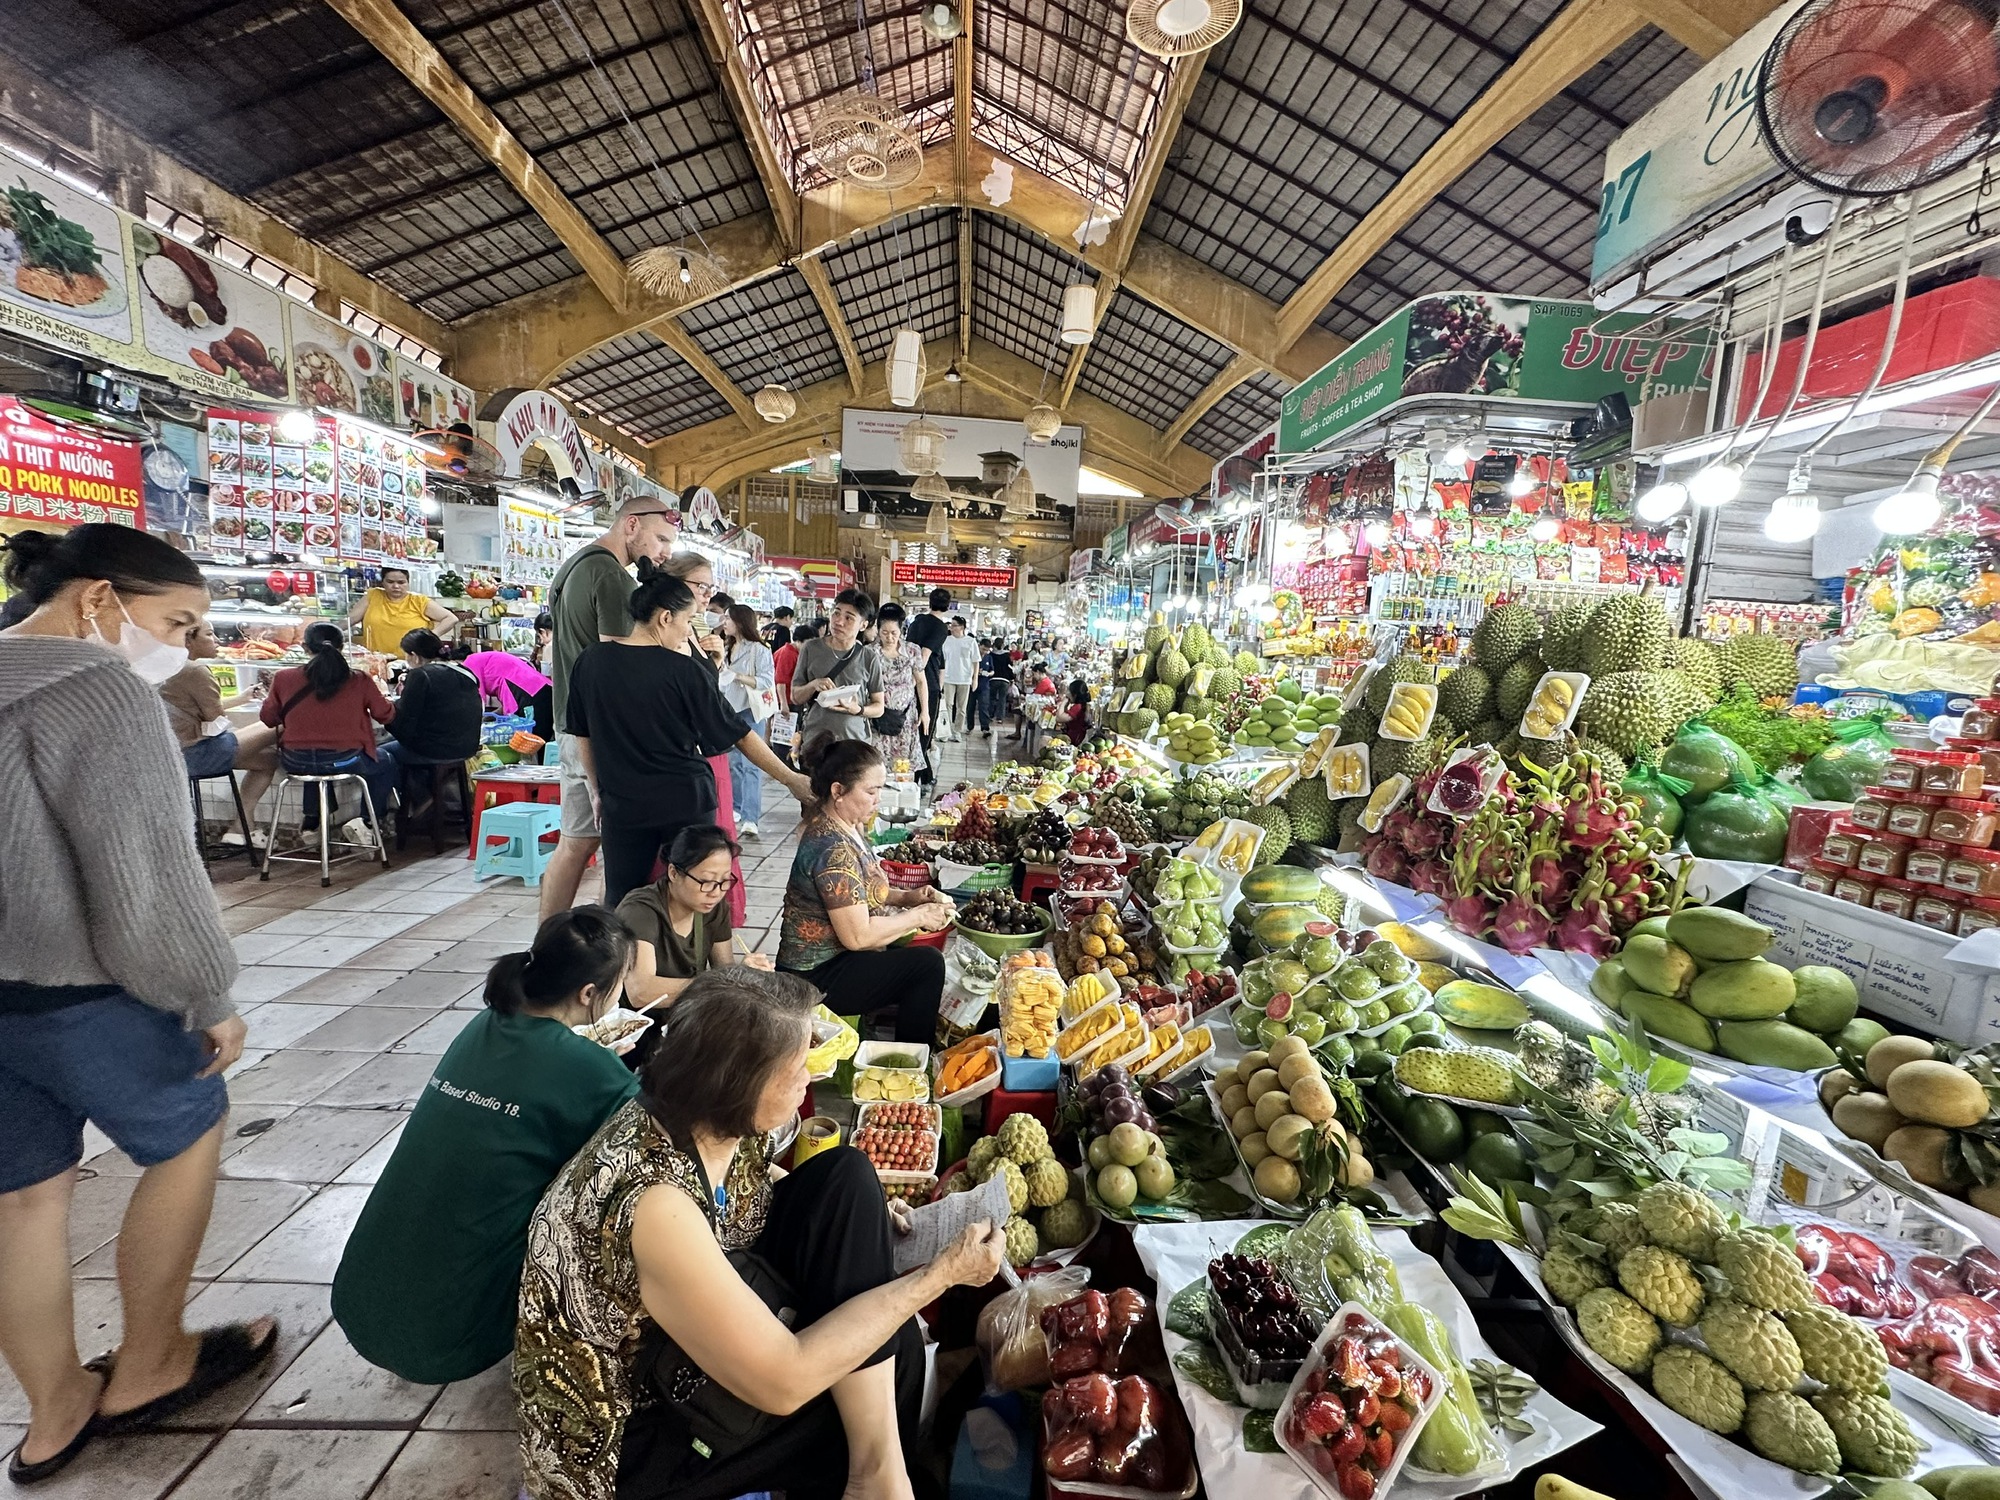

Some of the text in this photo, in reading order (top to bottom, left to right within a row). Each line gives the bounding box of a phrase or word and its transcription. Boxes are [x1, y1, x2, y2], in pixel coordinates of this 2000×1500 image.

[1560, 305, 1583, 318] 1069
[36, 325, 91, 351] PANCAKE
[176, 371, 231, 397] VIETNAMESE
[1351, 338, 1395, 392] TRANG
[236, 388, 254, 398] NAM
[1300, 422, 1319, 440] FRUITS
[1322, 406, 1344, 428] COFFEE
[1344, 405, 1350, 414] &
[1351, 396, 1363, 410] TEA
[1364, 382, 1384, 403] SHOP
[507, 402, 536, 449] KHU
[539, 395, 558, 435] ĂN
[12, 441, 54, 471] THỊT
[58, 450, 115, 481] NƯỚNG
[1050, 438, 1079, 450] shojiki
[16, 468, 65, 496] PORK
[68, 478, 140, 508] NOODLES
[440, 1080, 469, 1099] Based
[465, 1090, 501, 1111] Studio
[504, 1102, 521, 1118] 18.
